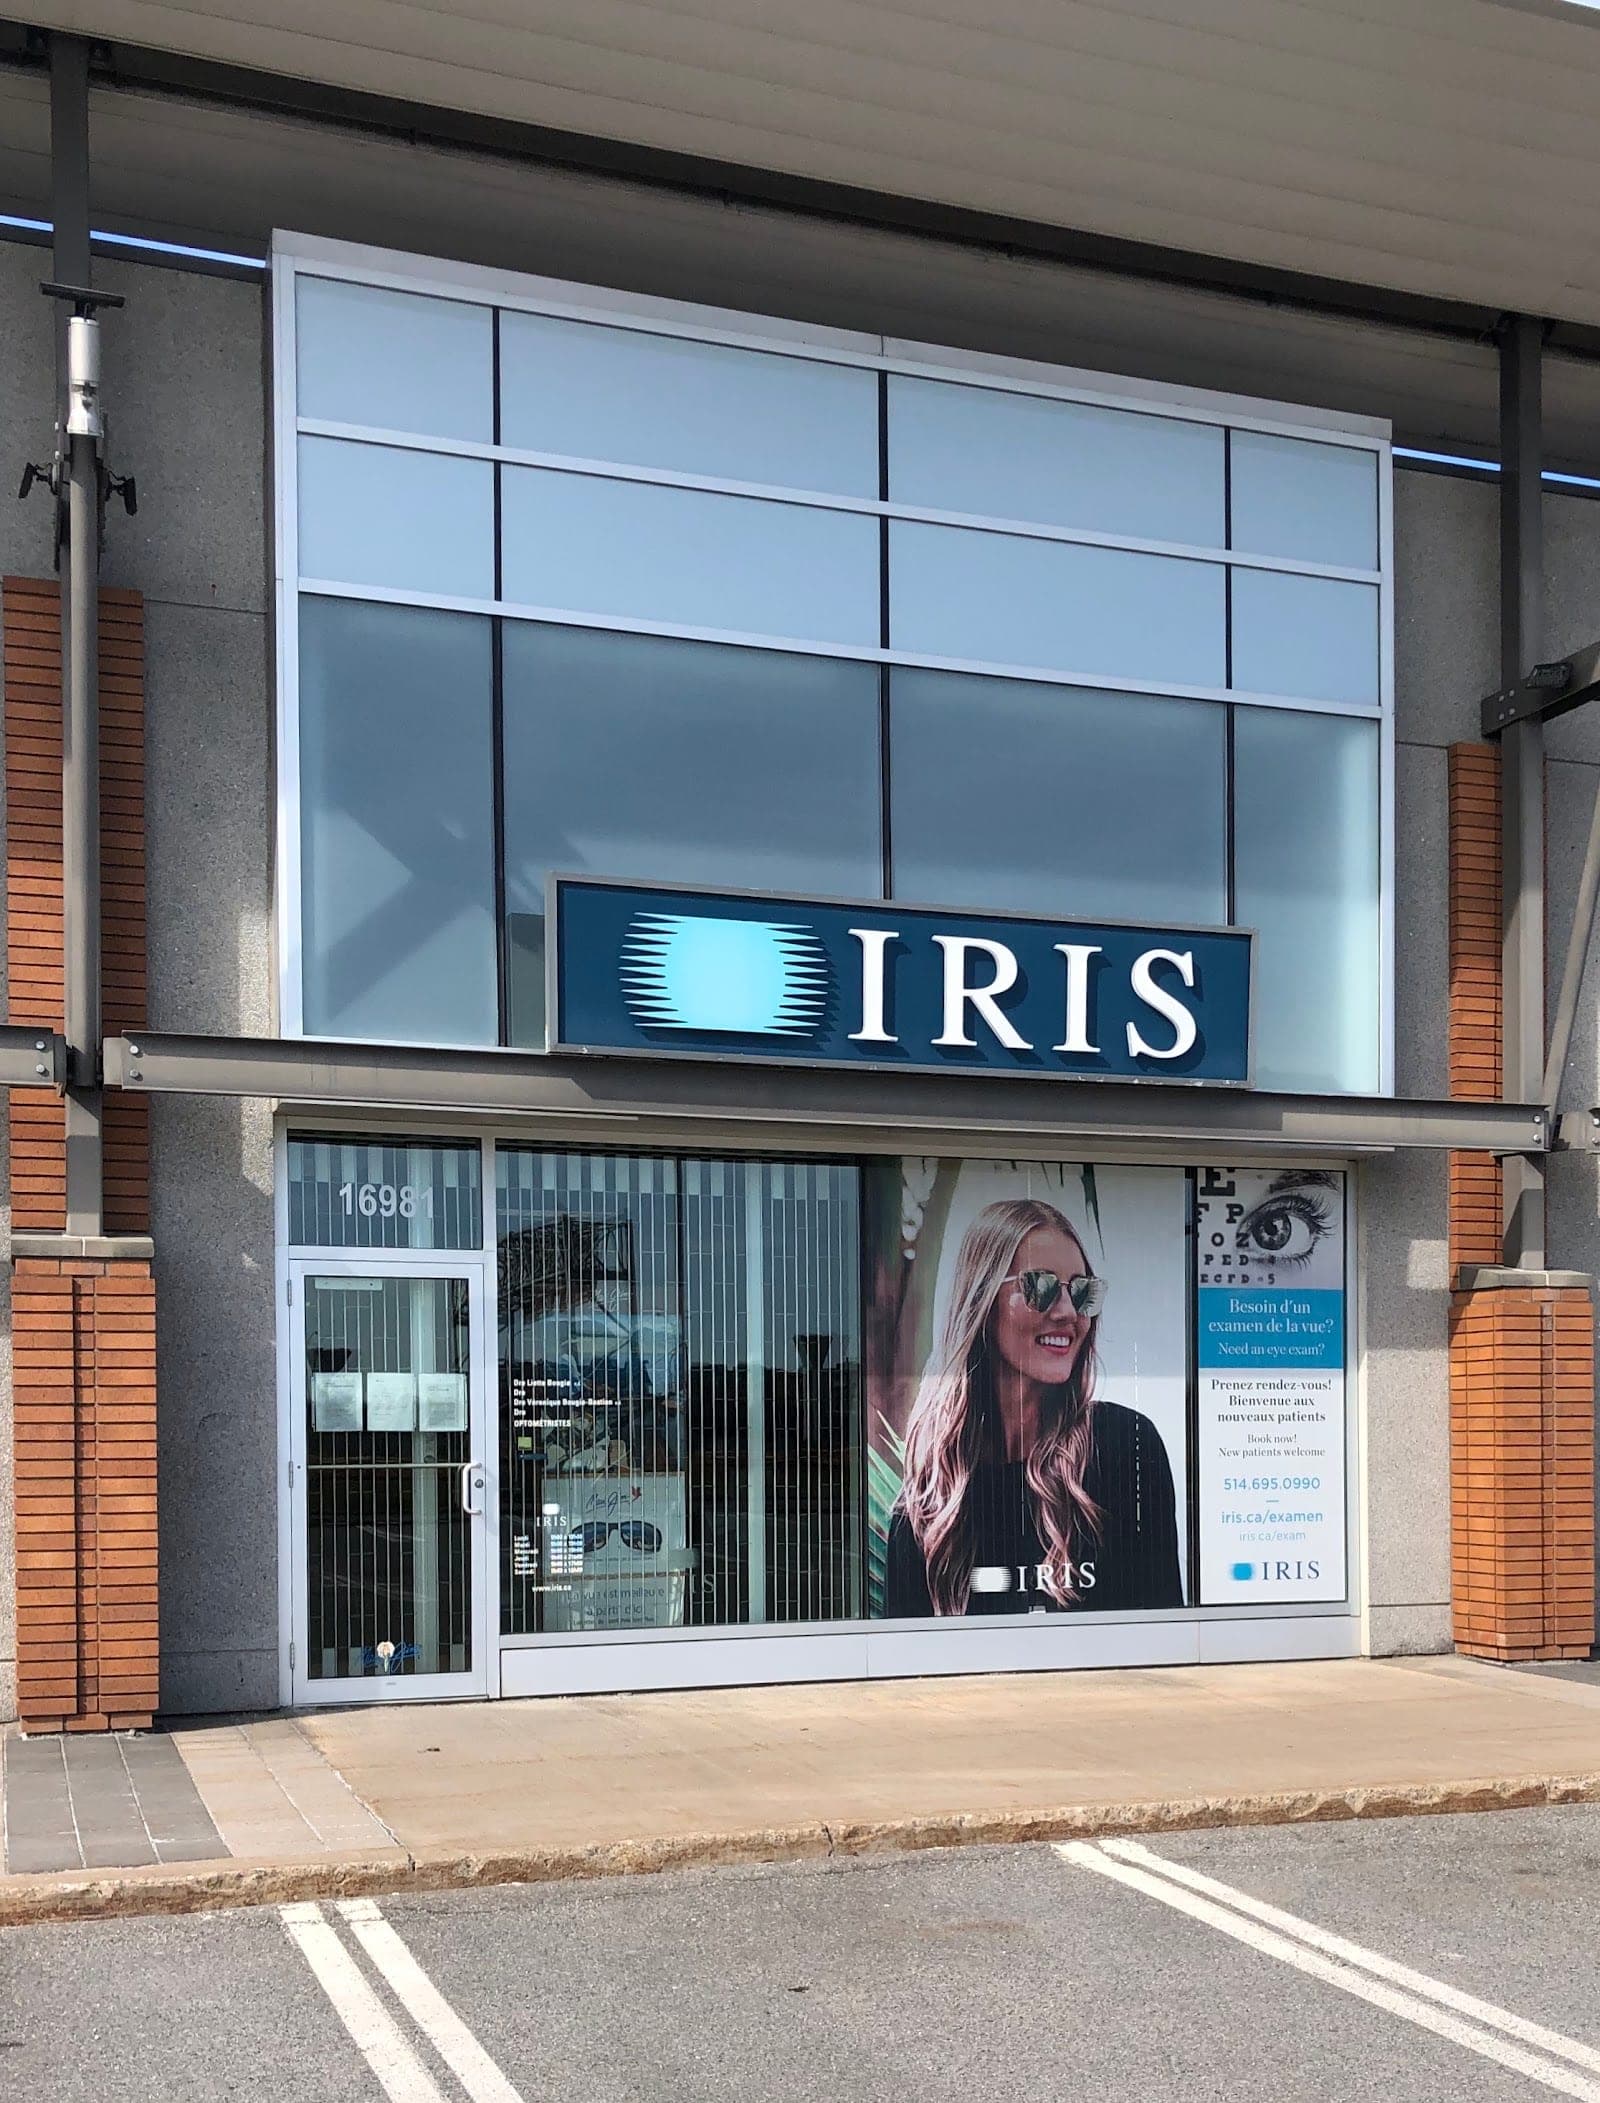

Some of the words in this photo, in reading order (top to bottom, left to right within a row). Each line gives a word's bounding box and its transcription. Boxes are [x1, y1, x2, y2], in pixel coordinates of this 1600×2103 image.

[847, 927, 1199, 1061] IRIS
[1199, 1167, 1236, 1197] E
[338, 1182, 434, 1219] 16981
[1229, 1298, 1277, 1314] Besoin
[1279, 1299, 1311, 1314] d'un
[1208, 1321, 1264, 1333] examen
[1266, 1318, 1283, 1333] de
[1286, 1318, 1299, 1333] la
[1301, 1318, 1334, 1334] vue?
[1218, 1342, 1249, 1355] Need
[1250, 1346, 1266, 1355] an
[1267, 1346, 1287, 1358] eye
[1288, 1343, 1325, 1356] exam?
[1211, 1379, 1254, 1391] Prenez
[1256, 1379, 1332, 1391] rendez-vous!
[1229, 1394, 1292, 1407] Bienvenue
[1293, 1397, 1316, 1407] aux
[1217, 1412, 1275, 1423] nouveaux
[1277, 1410, 1326, 1425] patients
[1247, 1433, 1272, 1444] Book
[1274, 1433, 1298, 1444] now!
[1218, 1447, 1240, 1457] New
[1242, 1446, 1282, 1459] patients
[1283, 1446, 1326, 1457] welcome
[1223, 1476, 1321, 1491] 514.695.0990
[536, 1515, 567, 1528] IRIS
[1221, 1509, 1324, 1525] iris.ca/examen
[1239, 1529, 1307, 1542] iris.ca/exam
[1016, 1561, 1097, 1593] IRIS
[1261, 1560, 1320, 1581] IRIS
[532, 1583, 573, 1592] www.iris.ca
